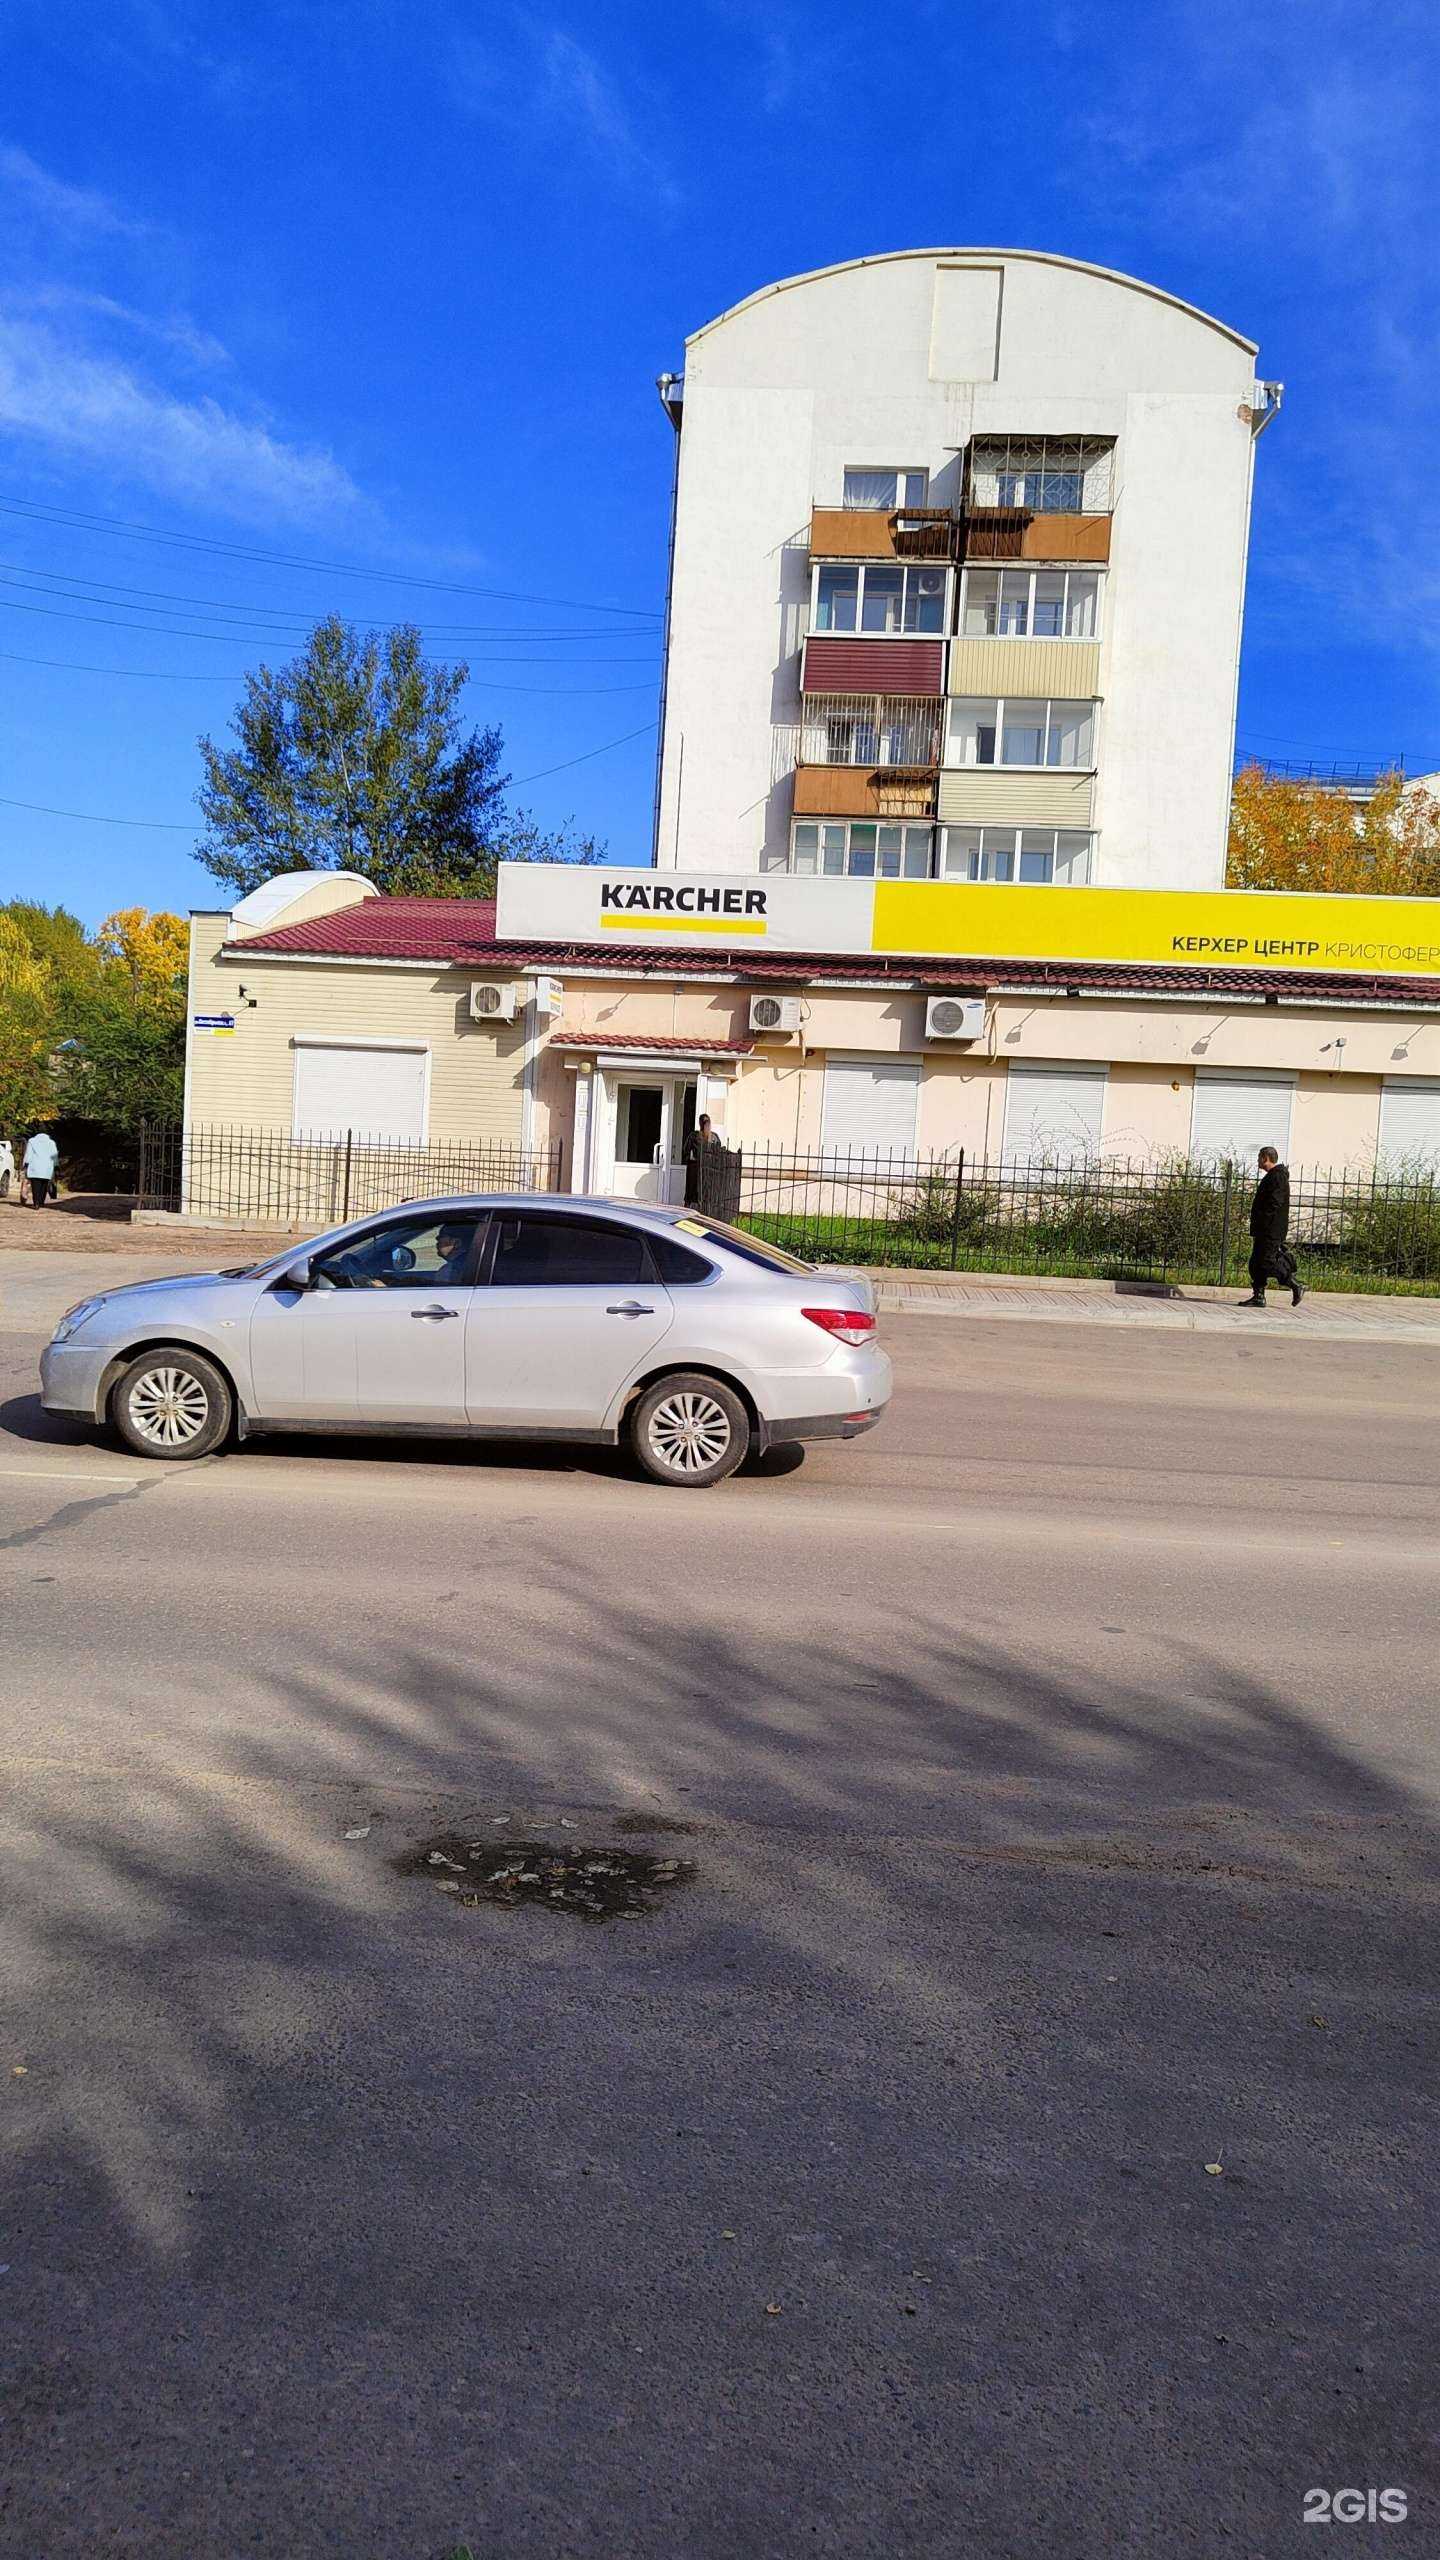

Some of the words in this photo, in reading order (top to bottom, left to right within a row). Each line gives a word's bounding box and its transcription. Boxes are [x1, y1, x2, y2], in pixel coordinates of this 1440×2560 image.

[601, 884, 767, 914] KÄRCHER
[1172, 936, 1248, 953] КЕРХЕР
[1254, 939, 1319, 957] ЦЕНТР
[1325, 942, 1440, 962] КРИСТОФЕР
